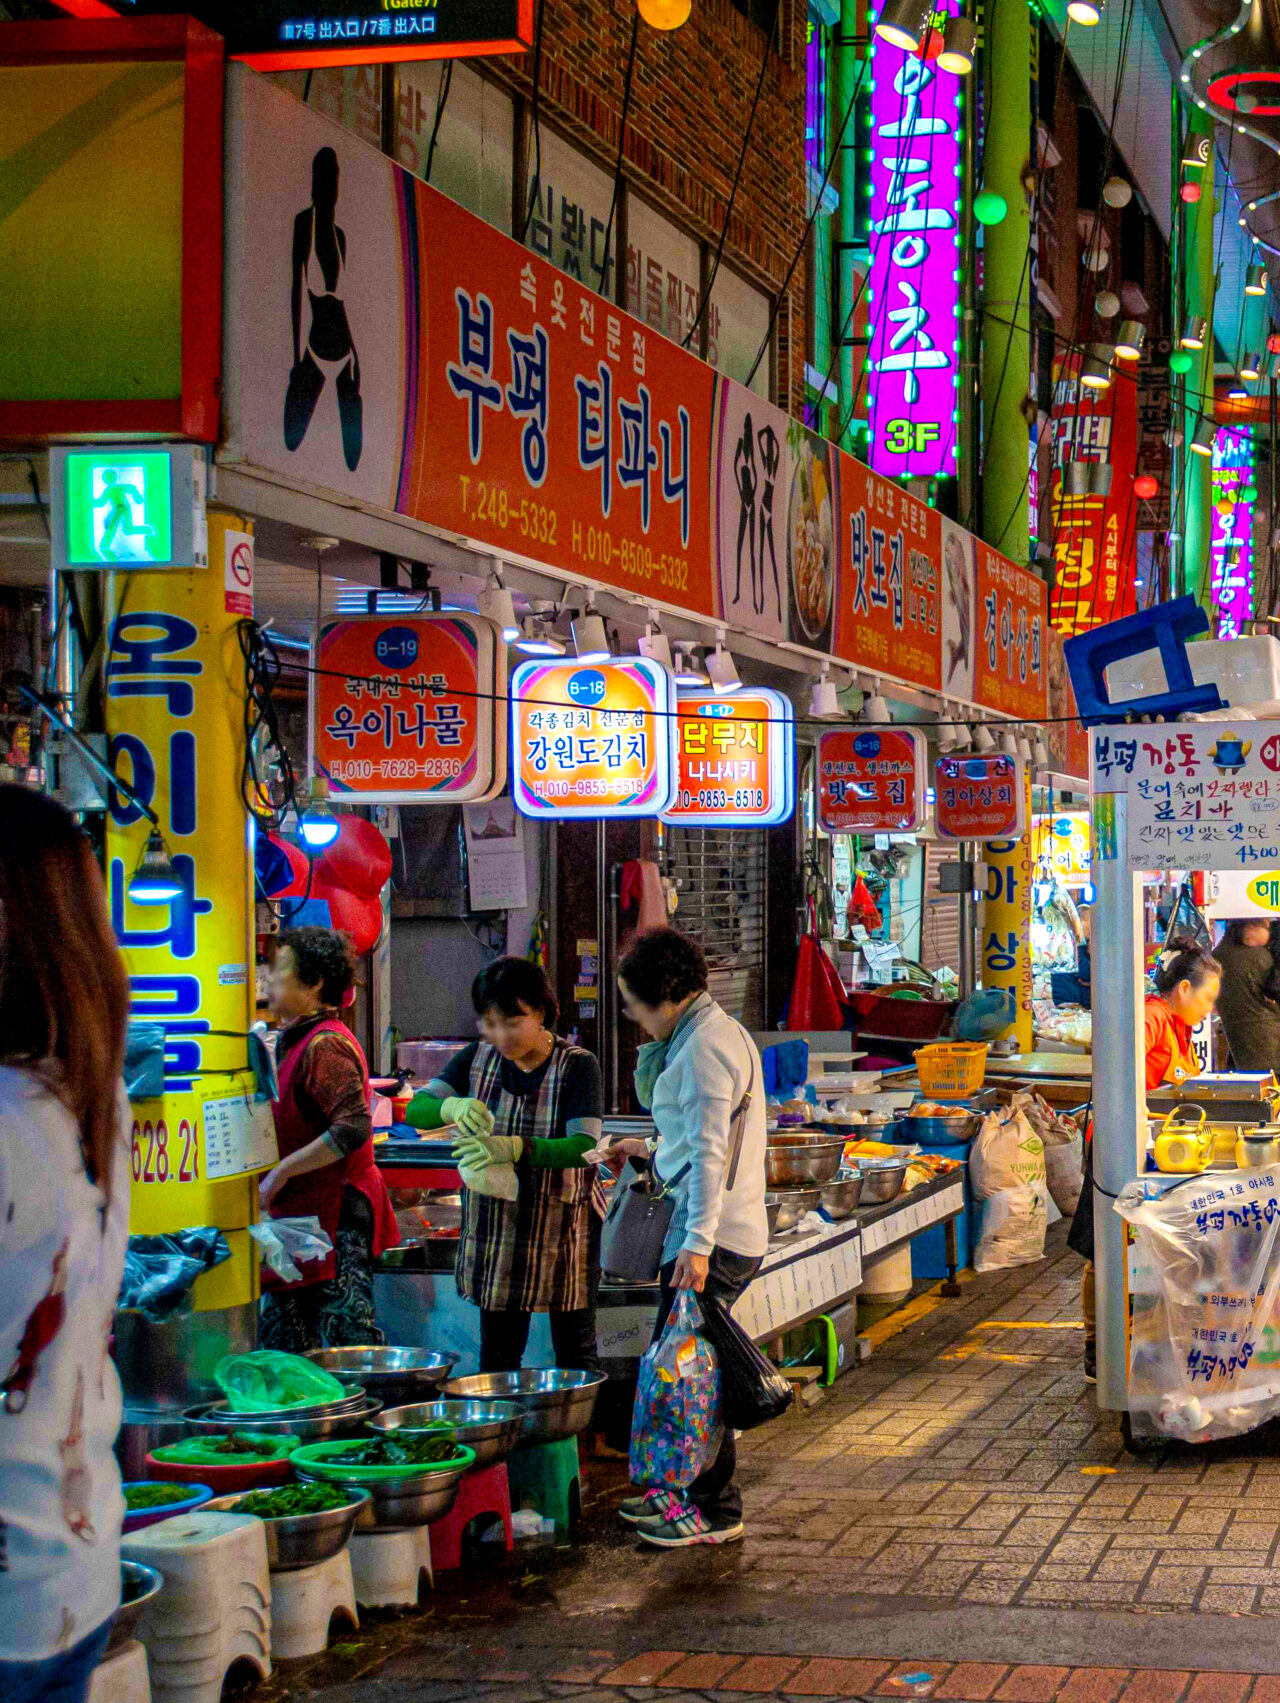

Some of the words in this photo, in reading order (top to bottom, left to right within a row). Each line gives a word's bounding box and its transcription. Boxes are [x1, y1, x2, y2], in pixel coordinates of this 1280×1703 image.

[874, 52, 956, 403] 오동추
[447, 288, 549, 488] 부평
[574, 361, 692, 549] 티파니
[886, 418, 941, 454] 3F
[459, 474, 558, 548] T.248-5332
[571, 518, 690, 593] H.010-8509-5332
[376, 640, 418, 658] B-19
[984, 588, 1042, 691] 경아상회
[345, 674, 401, 699] 국내산
[408, 673, 446, 697] 나물
[569, 680, 604, 695] B-18
[326, 704, 466, 749] 옥이나물
[529, 711, 590, 731] 각종김치
[599, 708, 644, 728] 전문점
[705, 706, 730, 717] B-17
[527, 733, 647, 772] 강원도김치
[683, 721, 764, 755] 단무지
[330, 757, 462, 781] H.010-7628-2836
[1095, 736, 1138, 777] 부평
[1142, 733, 1201, 777] 깡통
[688, 760, 757, 783] 나나시키
[534, 778, 643, 798] H.010-9853-8518
[942, 784, 1012, 808] 경아상회
[107, 611, 213, 1092] 옥이나물
[1249, 1175, 1275, 1189] 야시장
